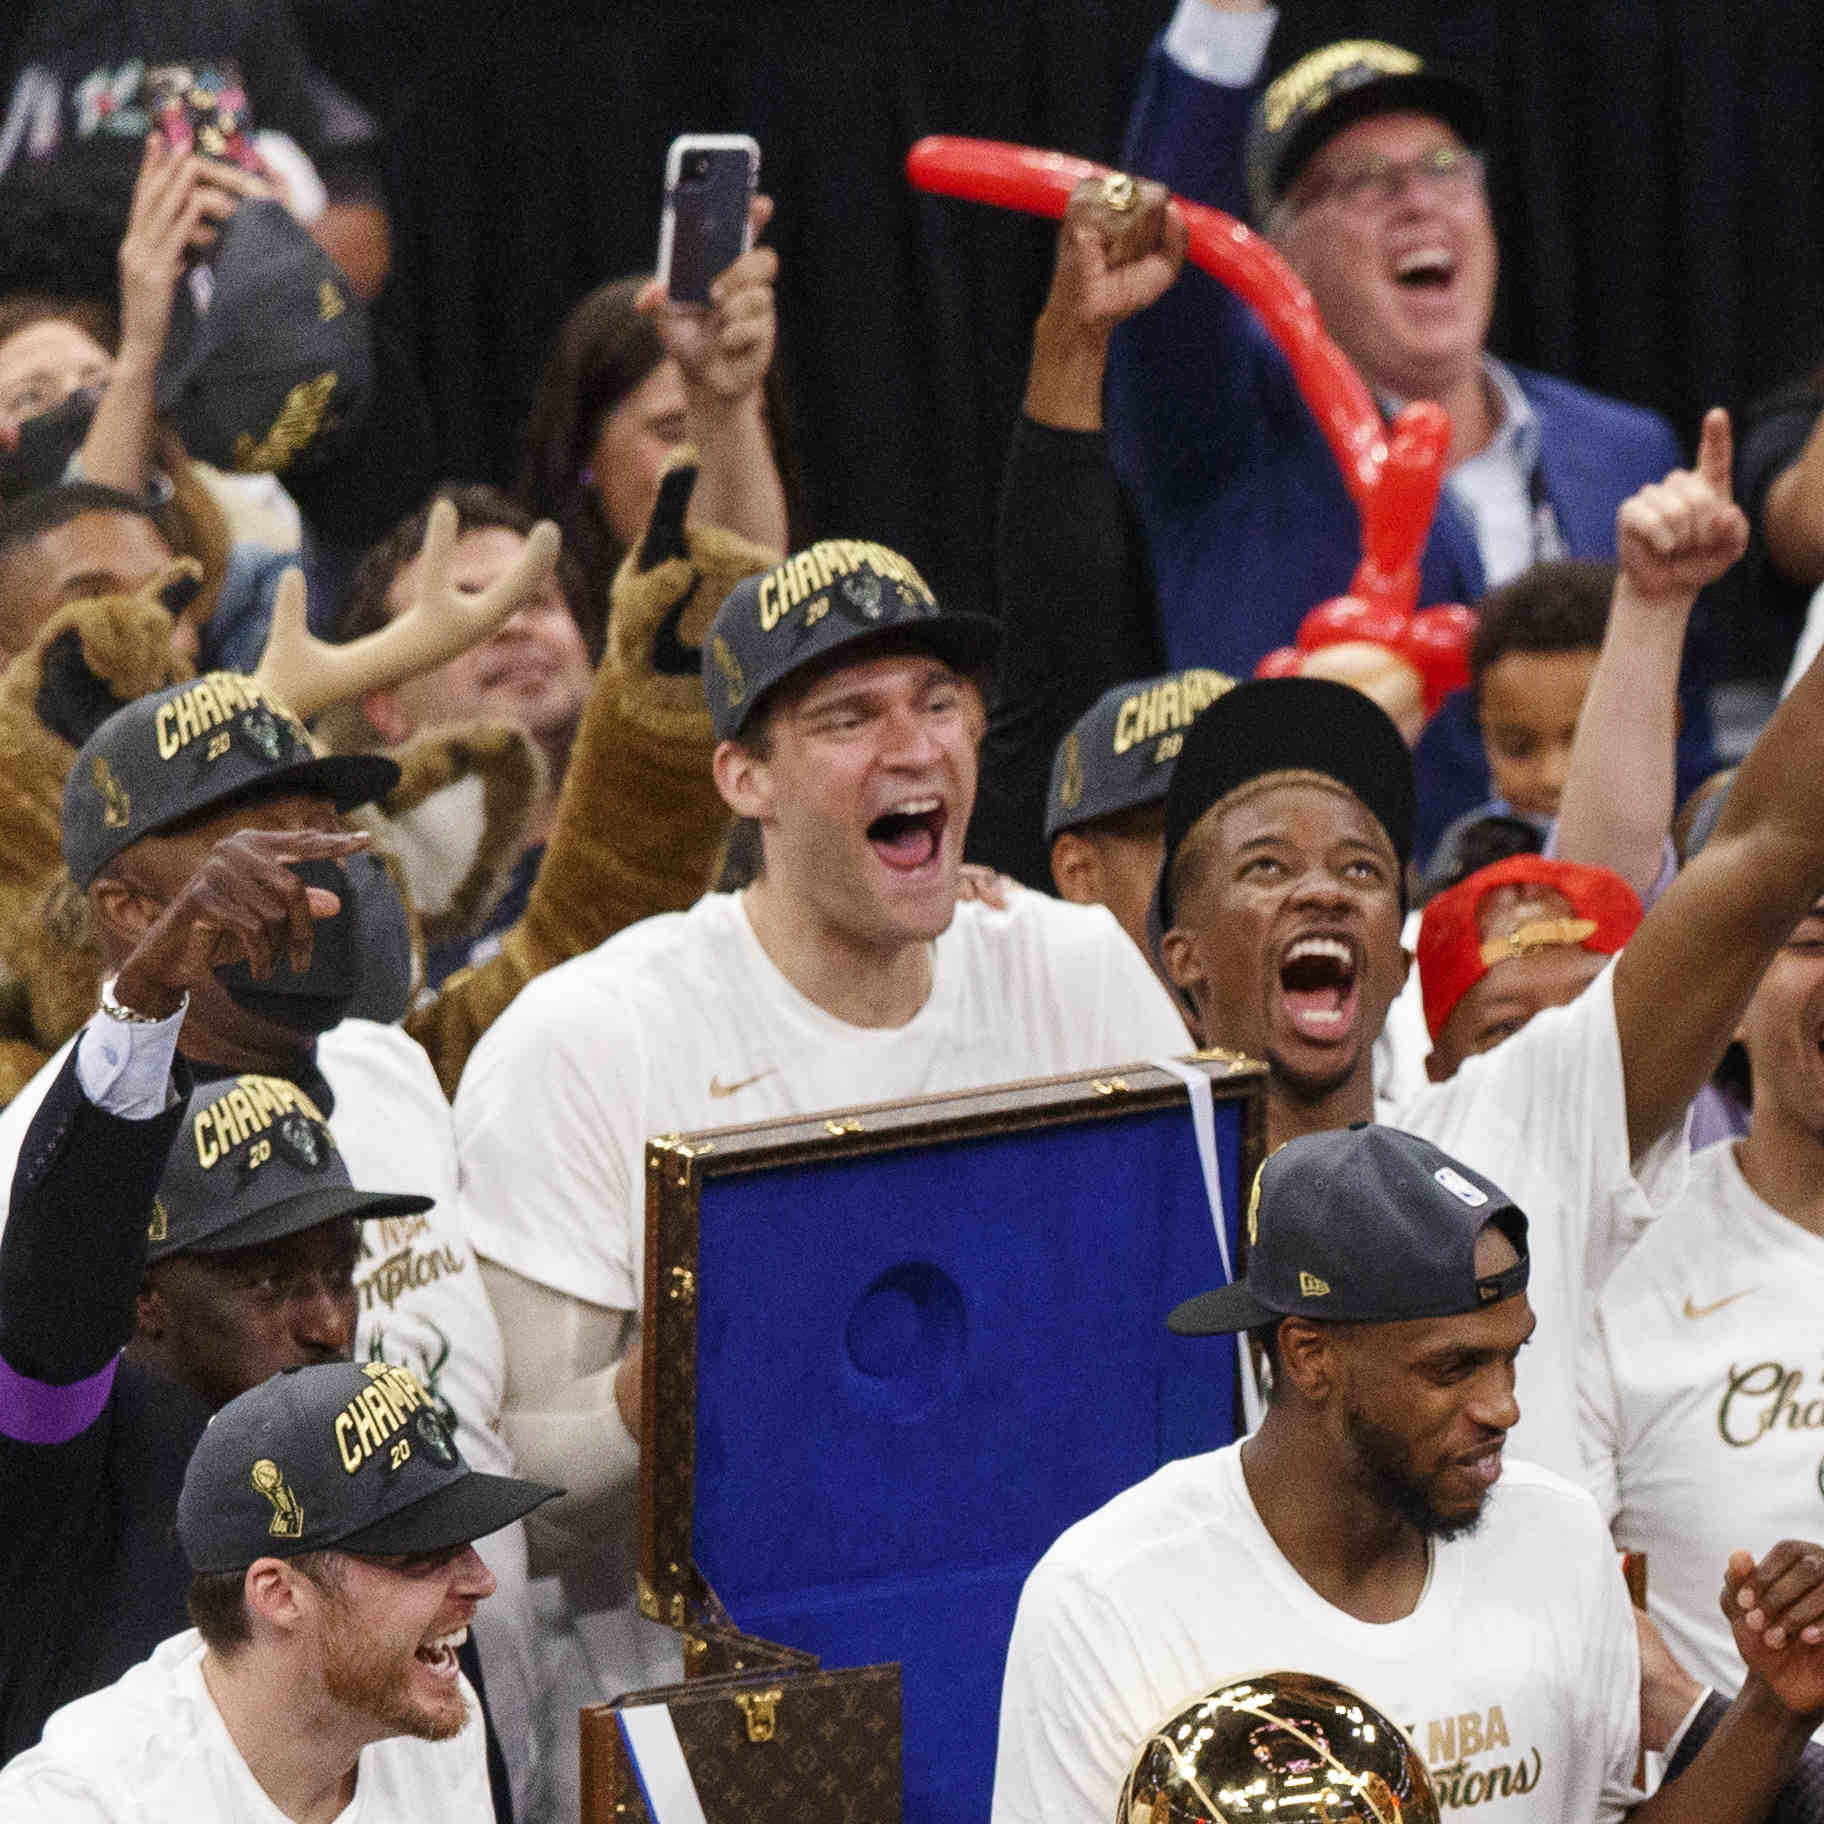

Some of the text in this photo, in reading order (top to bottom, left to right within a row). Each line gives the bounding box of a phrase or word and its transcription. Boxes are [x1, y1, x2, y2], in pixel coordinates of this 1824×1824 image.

[335, 1366, 433, 1475] CHAMP
[390, 1438, 411, 1471] 20
[1426, 1704, 1511, 1766] NBA
